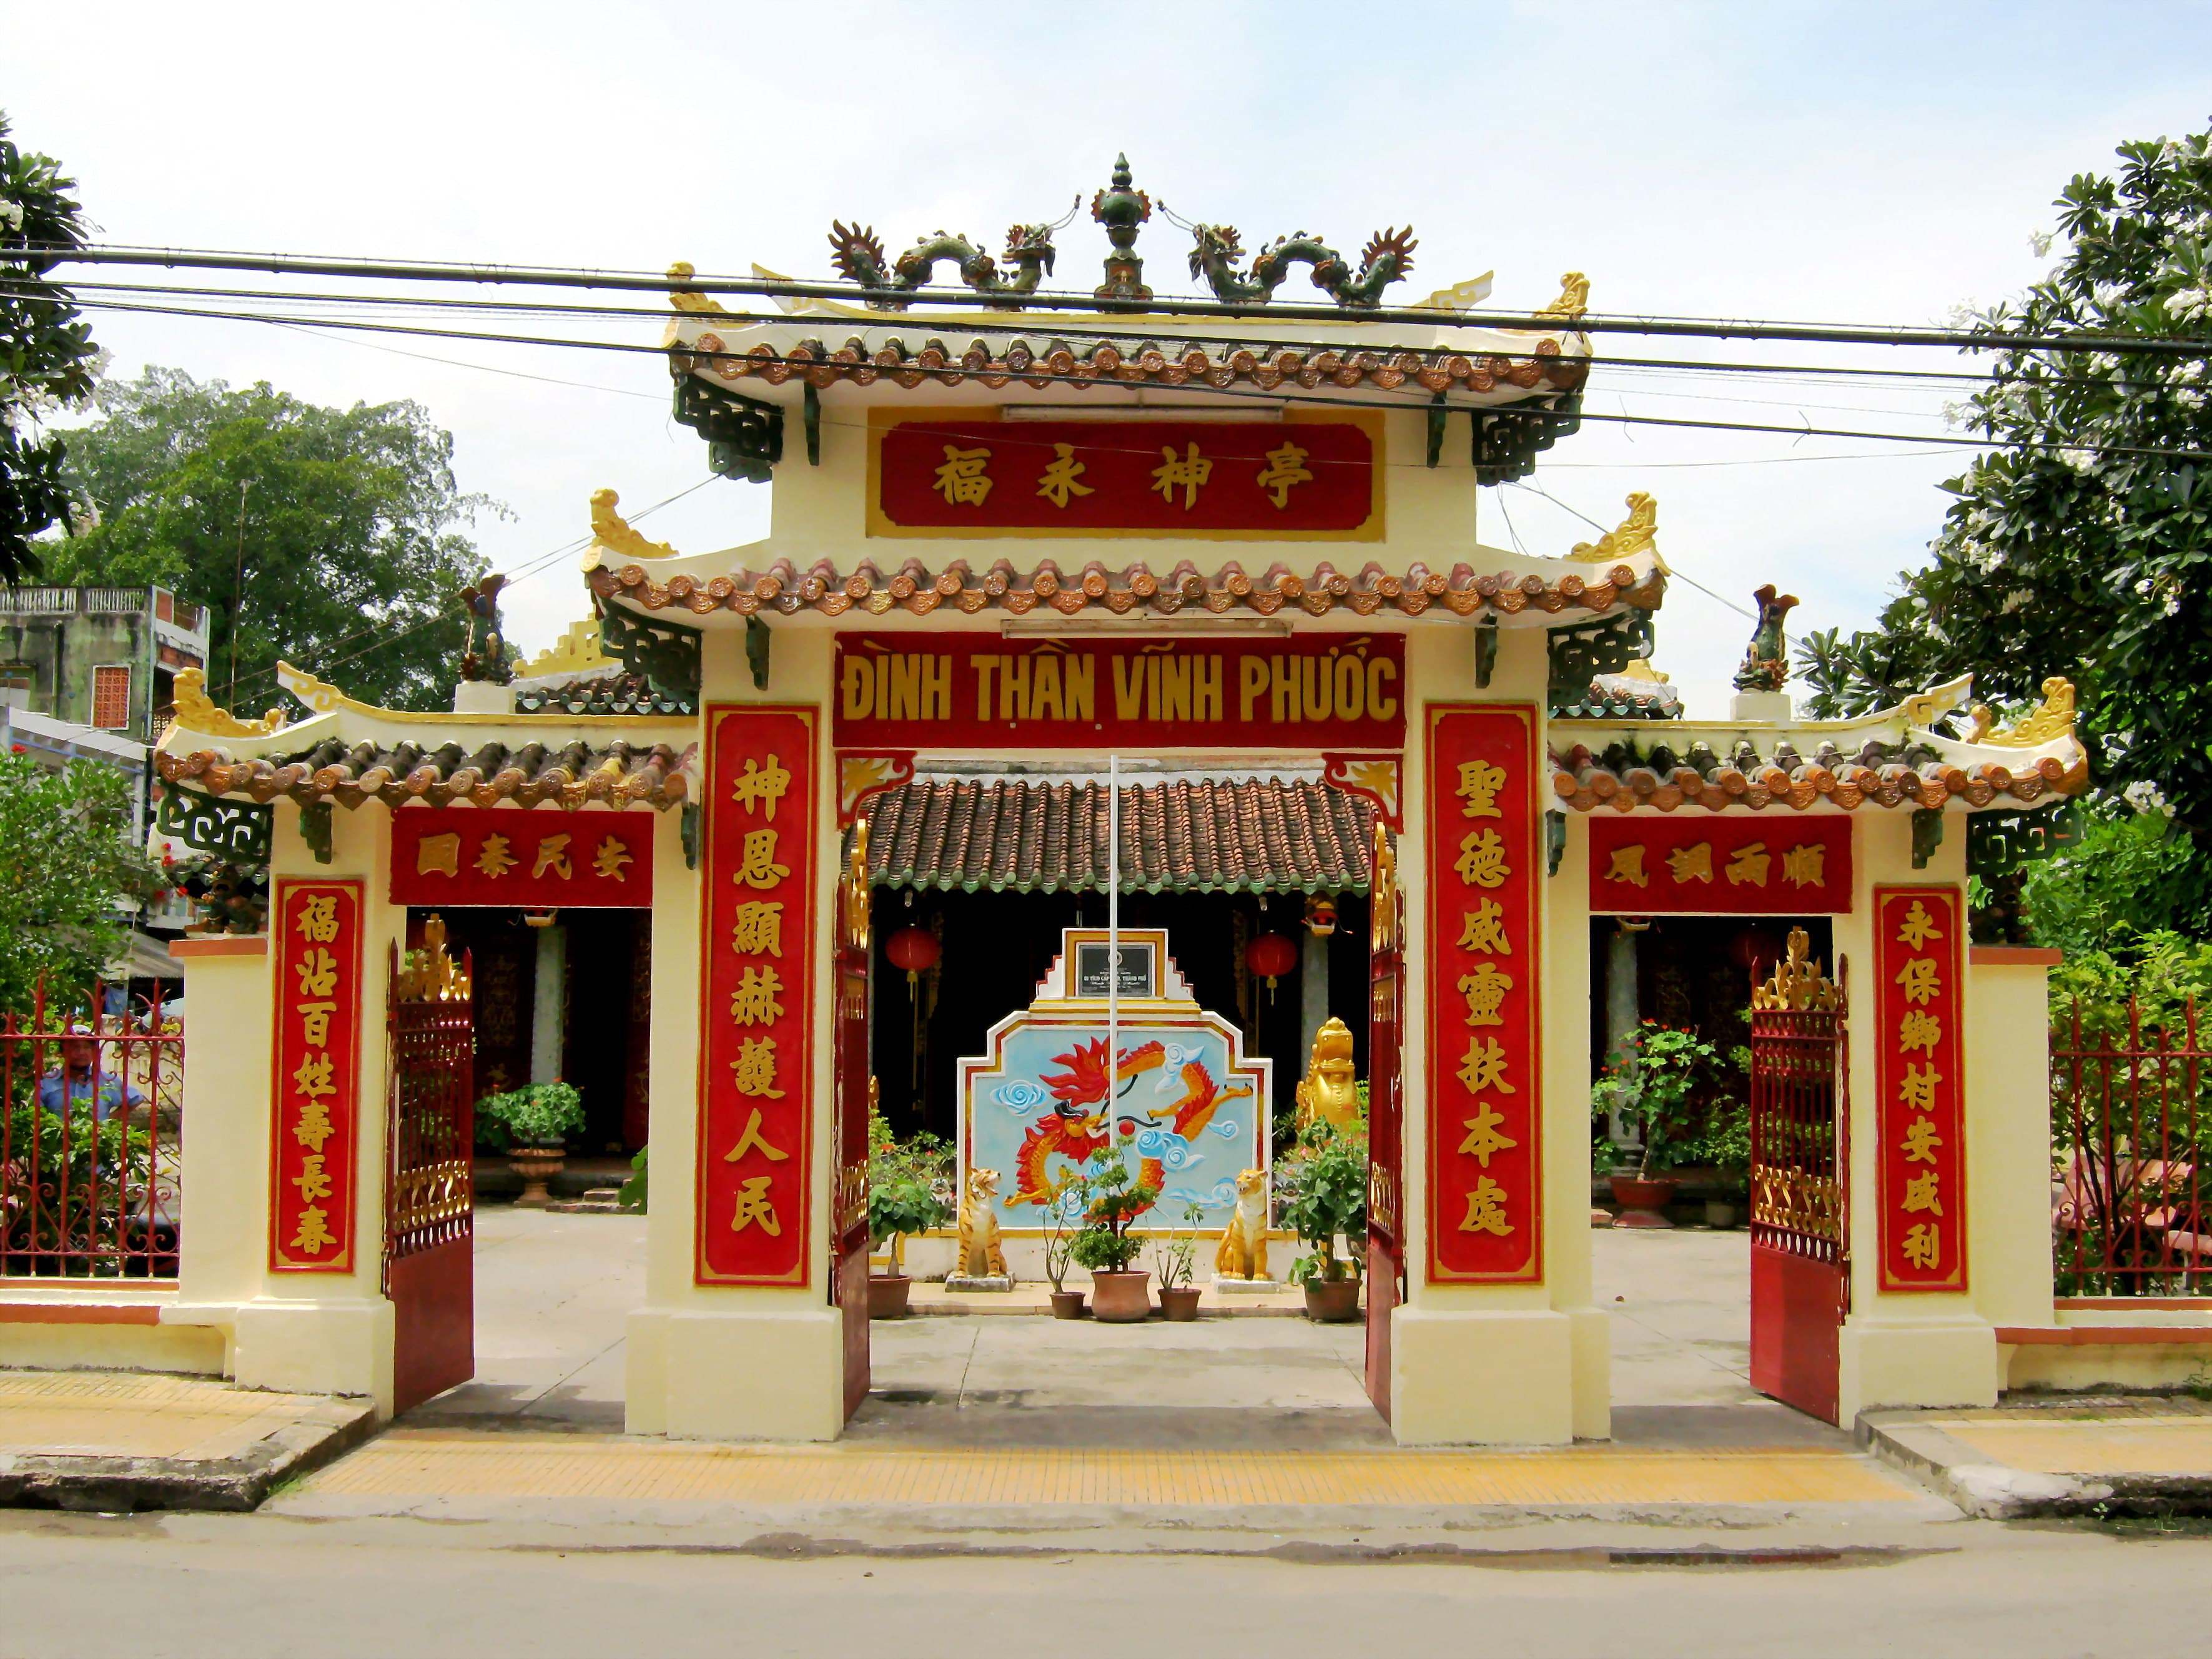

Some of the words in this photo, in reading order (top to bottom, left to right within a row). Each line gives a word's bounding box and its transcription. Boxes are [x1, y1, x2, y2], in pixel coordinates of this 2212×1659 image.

[841, 639, 952, 721] ĐÌNH
[970, 638, 1095, 721] THẦN
[1112, 641, 1223, 722] VĨNH
[1240, 637, 1397, 723] PHƯỚC
